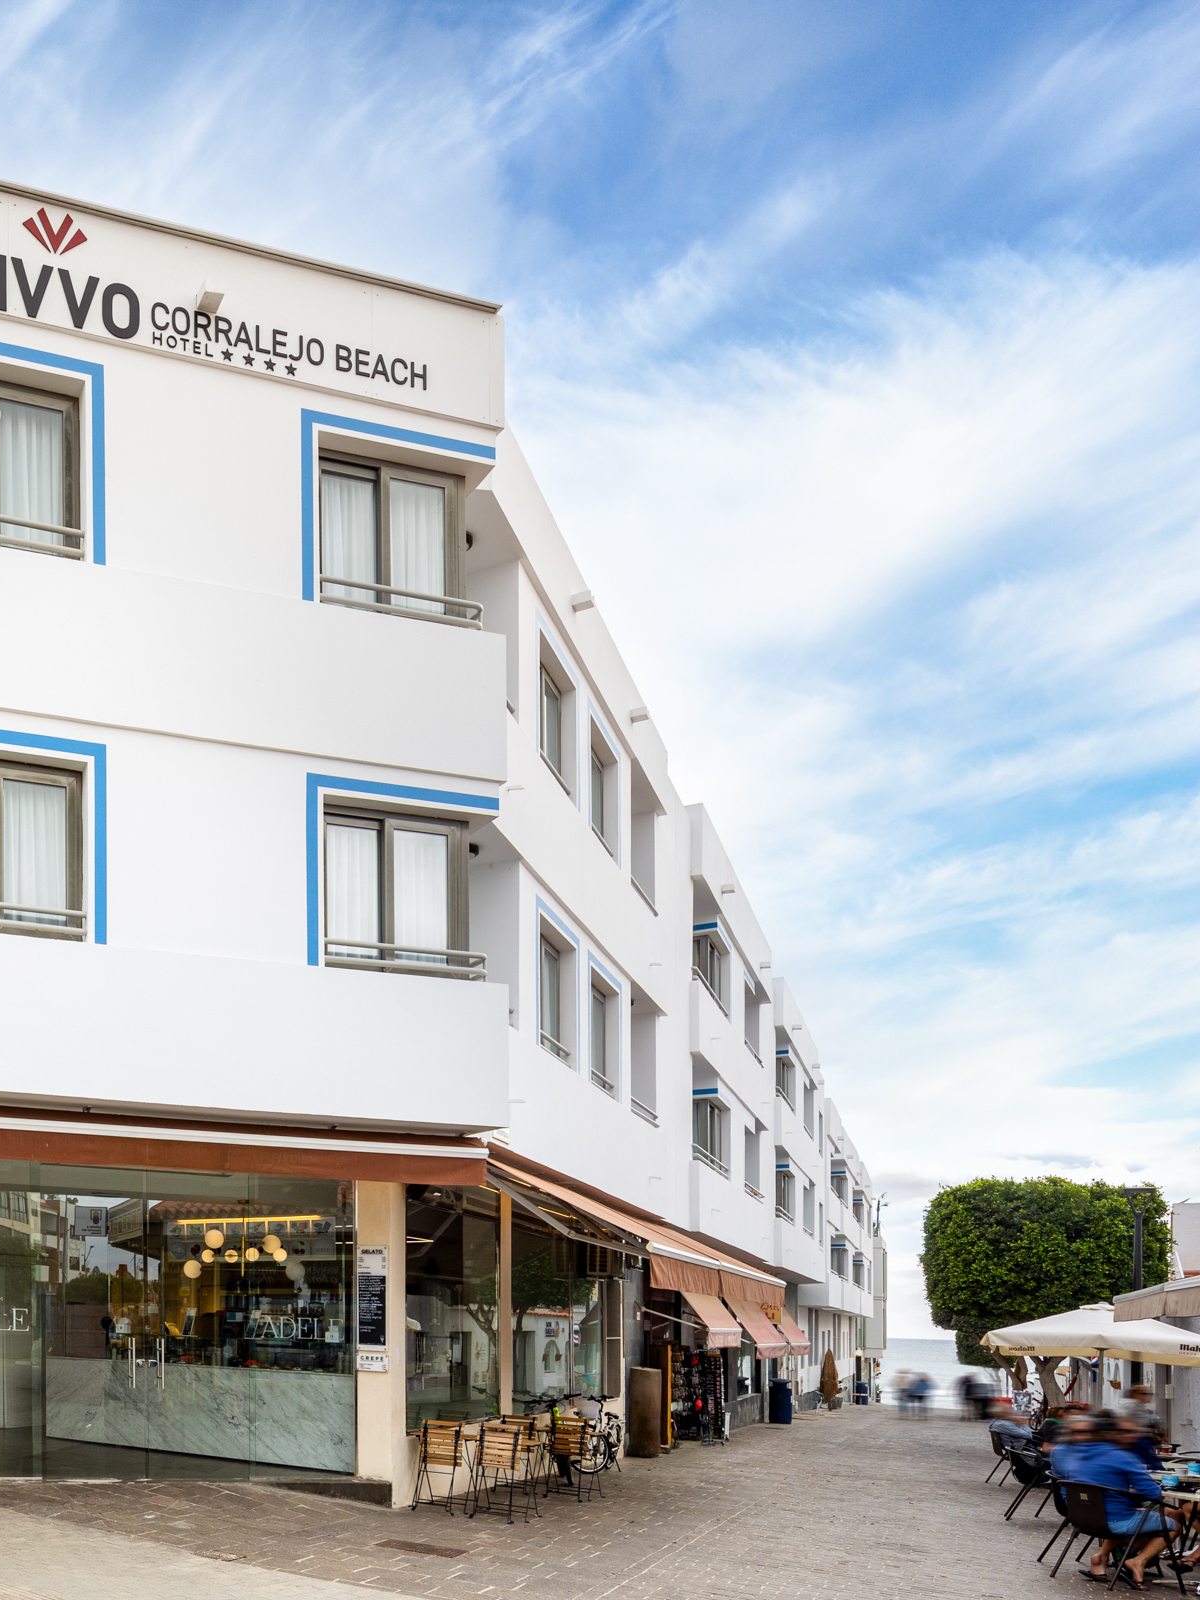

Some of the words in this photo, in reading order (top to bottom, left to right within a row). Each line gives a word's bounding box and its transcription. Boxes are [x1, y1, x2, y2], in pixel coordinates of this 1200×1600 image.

[151, 302, 325, 366] CORRALEJO
[335, 343, 428, 391] BEACH
[152, 331, 214, 358] HOTEL
[261, 1316, 345, 1341] ADELE
